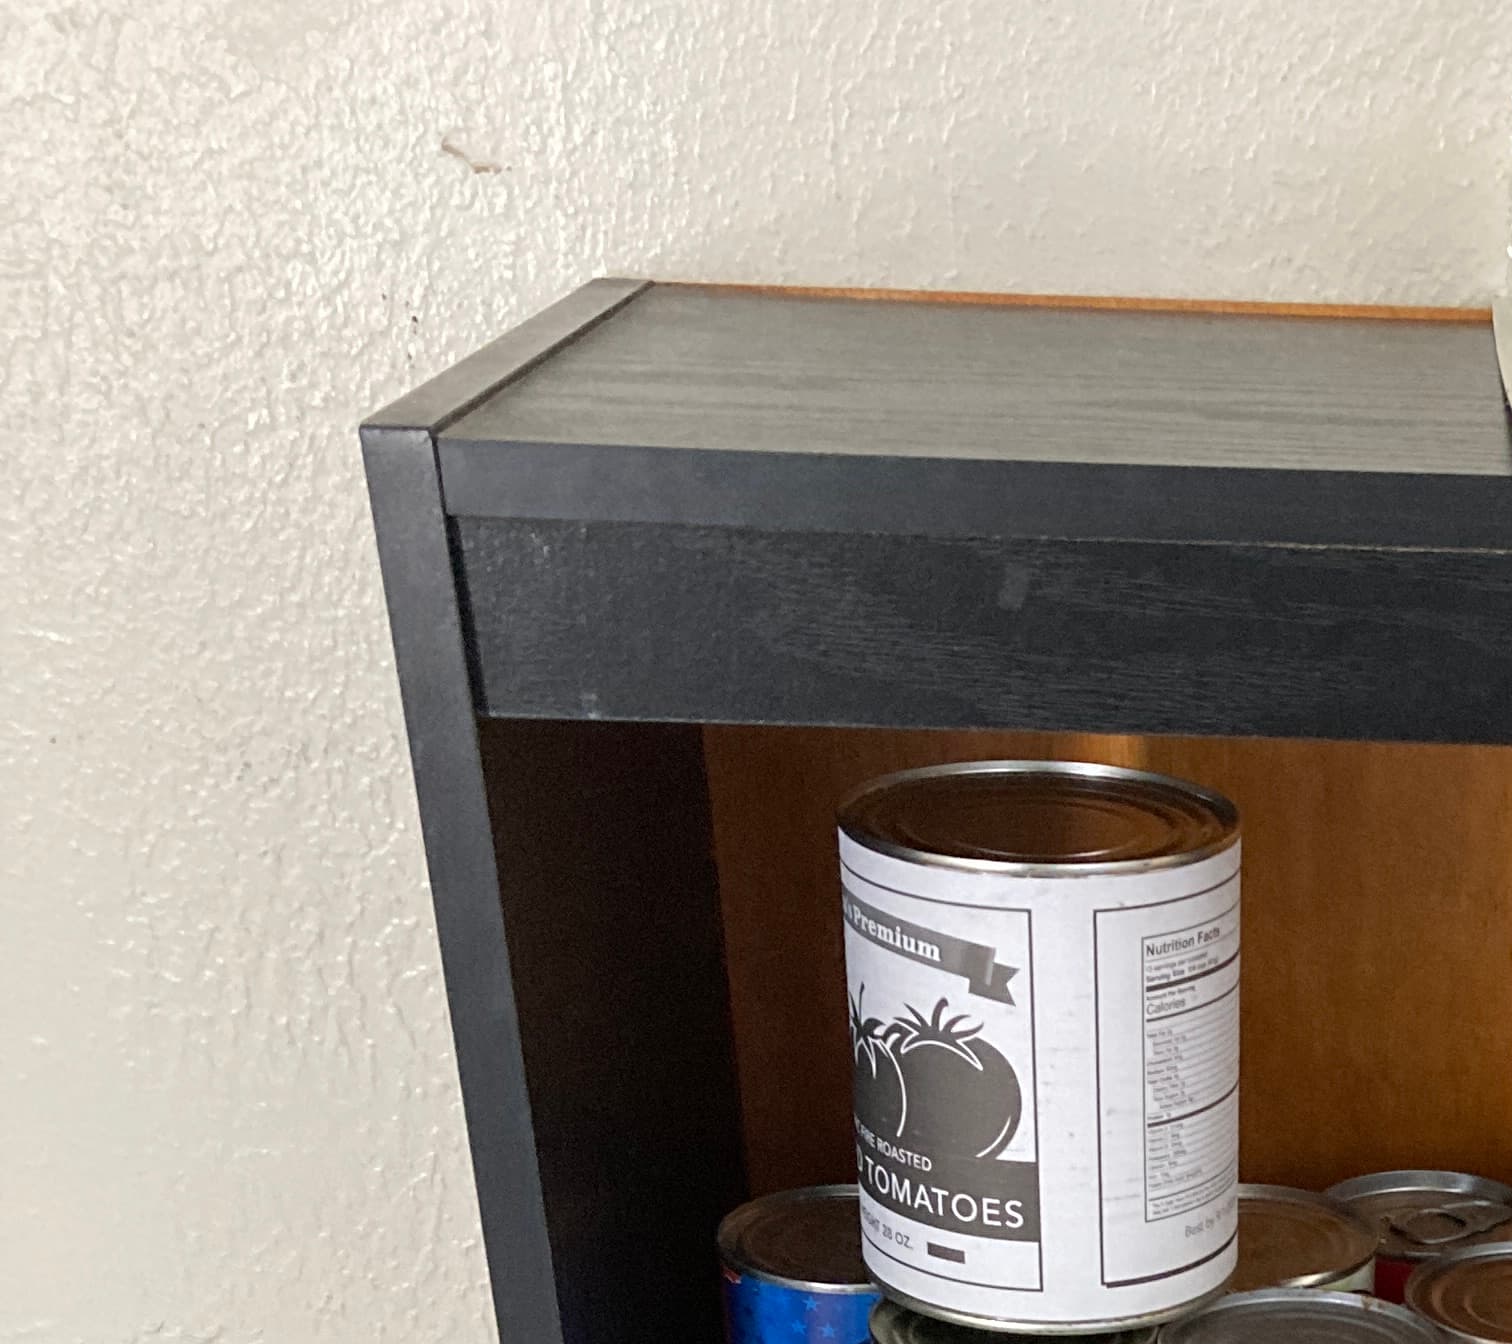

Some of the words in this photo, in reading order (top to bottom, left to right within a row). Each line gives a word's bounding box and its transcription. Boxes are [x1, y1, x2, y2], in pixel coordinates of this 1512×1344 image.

[853, 904, 941, 962] Premium
[1146, 936, 1195, 957] Nutrition
[1197, 927, 1220, 943] Facts
[1146, 999, 1186, 1015] Calories
[877, 1137, 932, 1172] ROASTED
[865, 1155, 1024, 1229] TOMATOES
